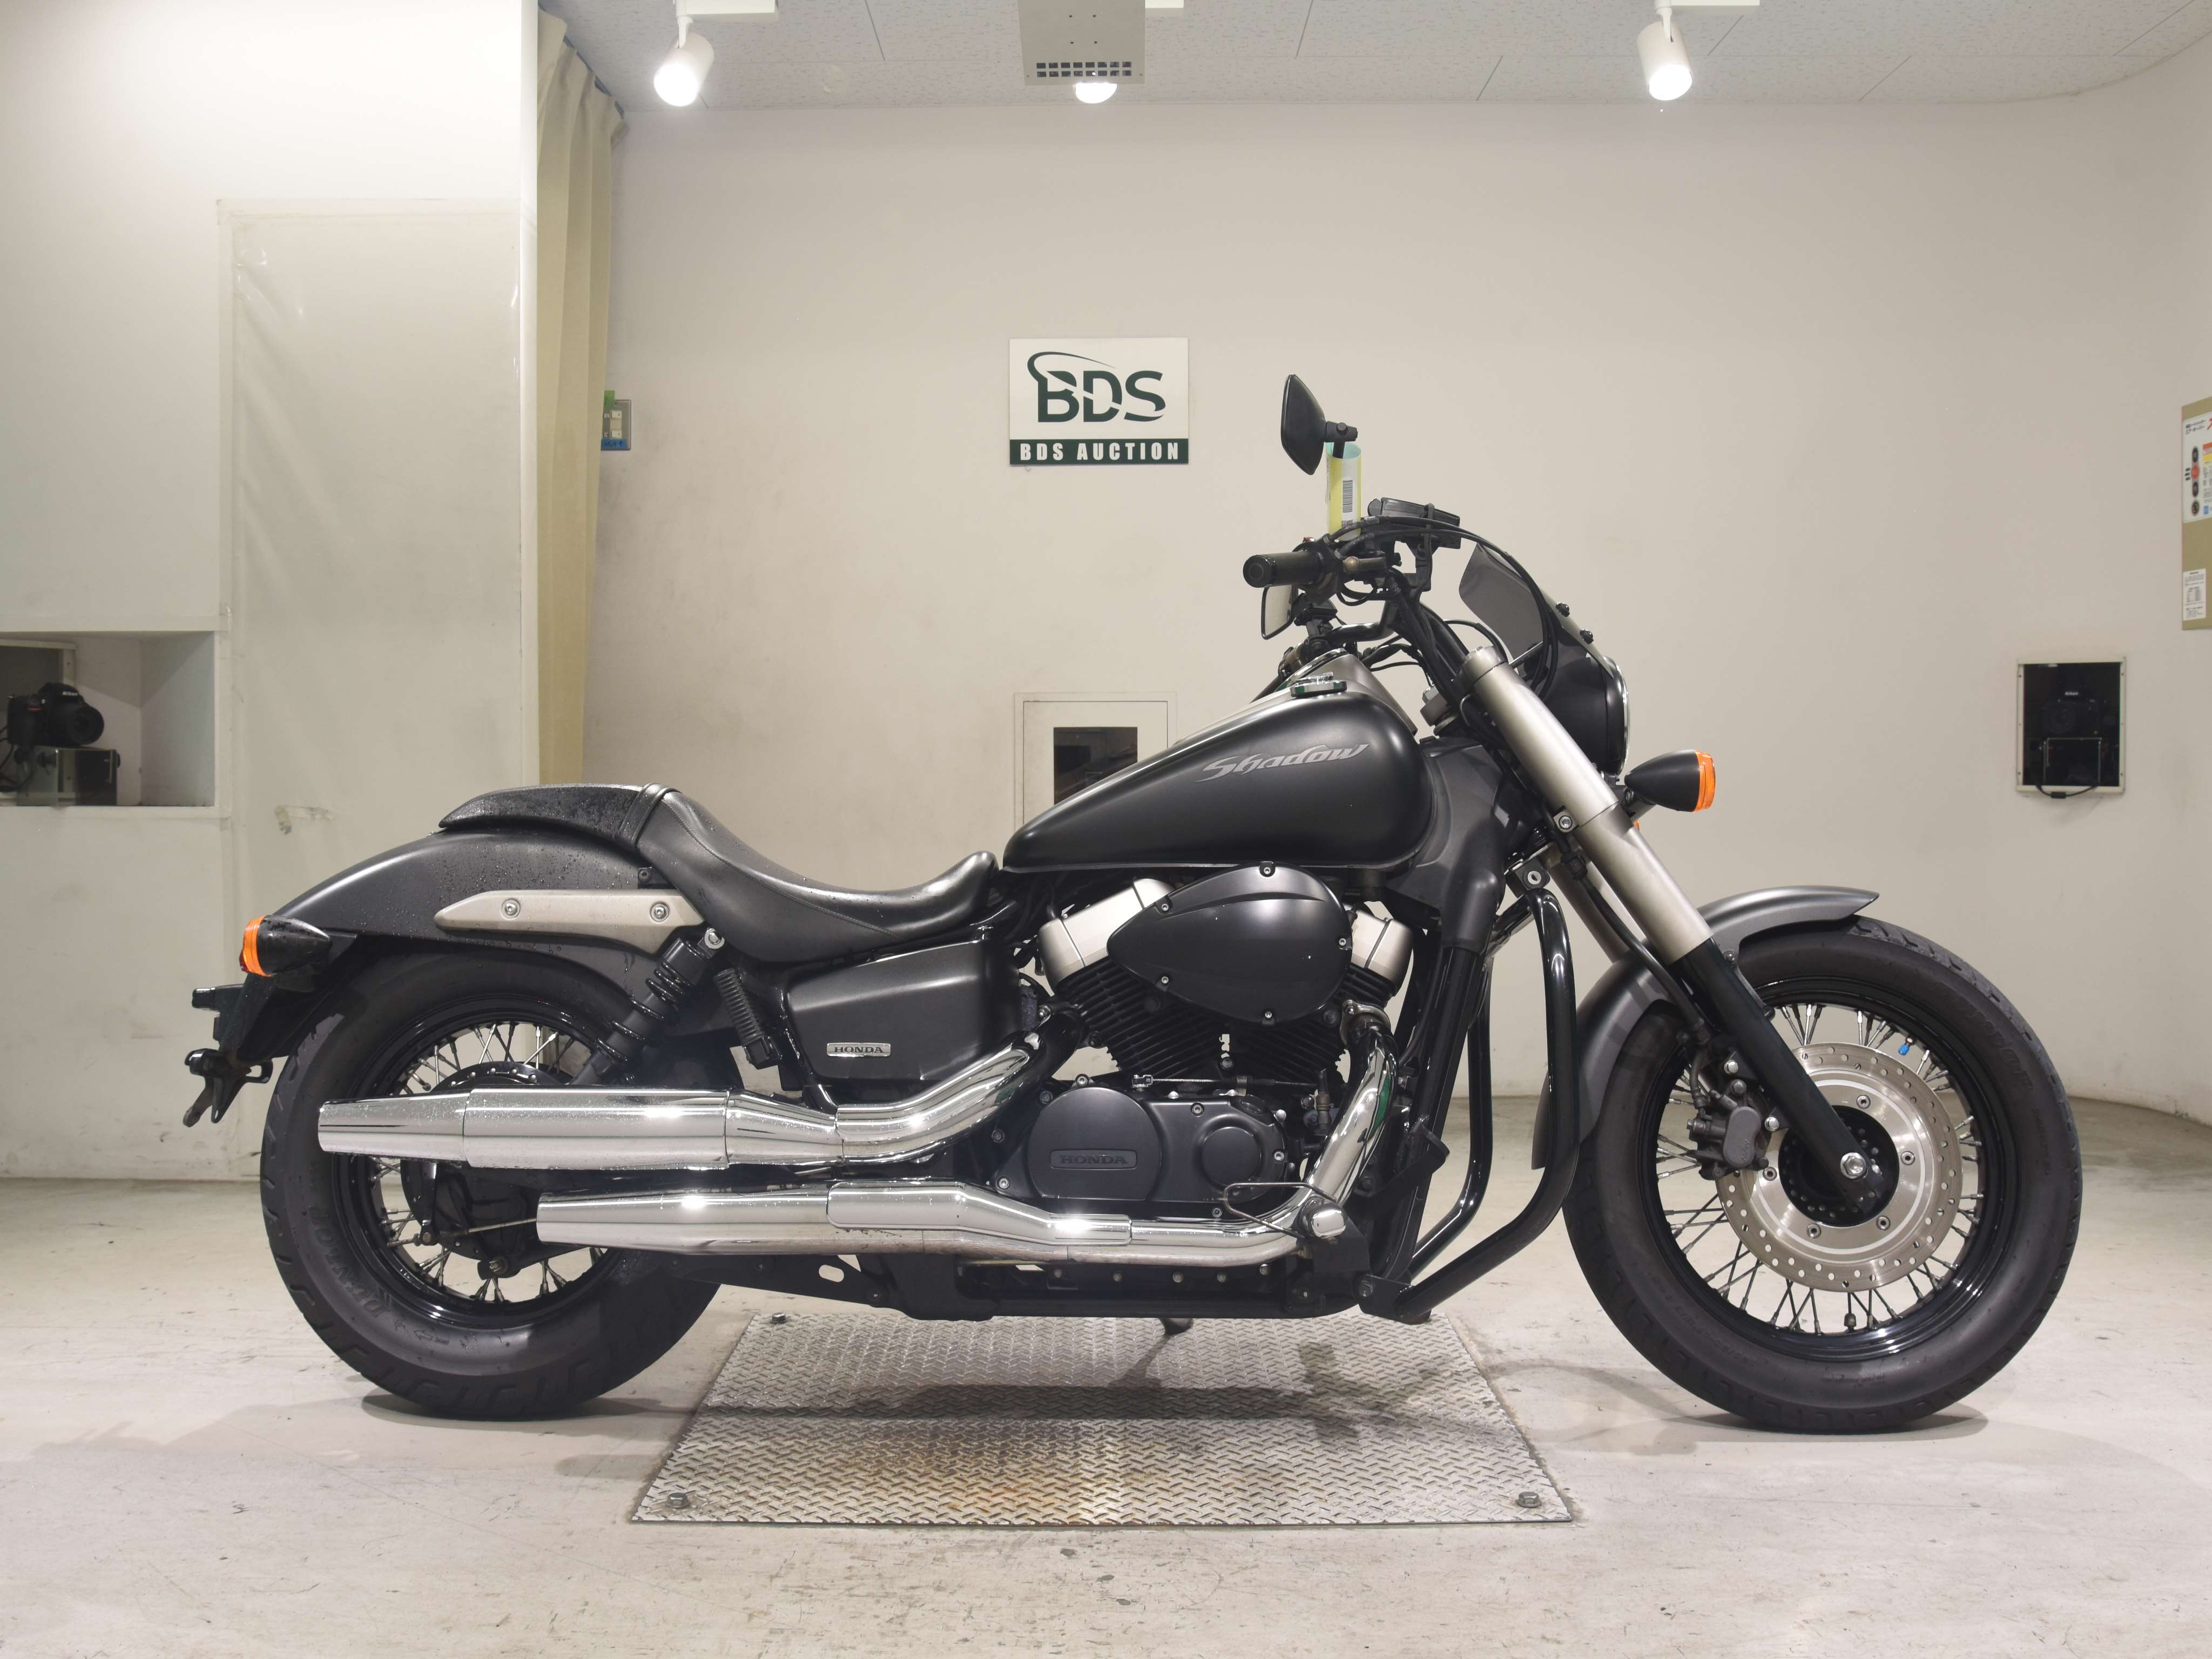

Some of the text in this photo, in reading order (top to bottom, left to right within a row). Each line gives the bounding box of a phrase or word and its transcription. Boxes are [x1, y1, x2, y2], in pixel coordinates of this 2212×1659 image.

[1027, 352, 1166, 422] BDS
[1020, 442, 1178, 460] BDS AUCTION
[1193, 743, 1370, 783] Shadow
[1060, 1155, 1129, 1164] HONDA
[308, 1205, 390, 1318] DUNLOP
